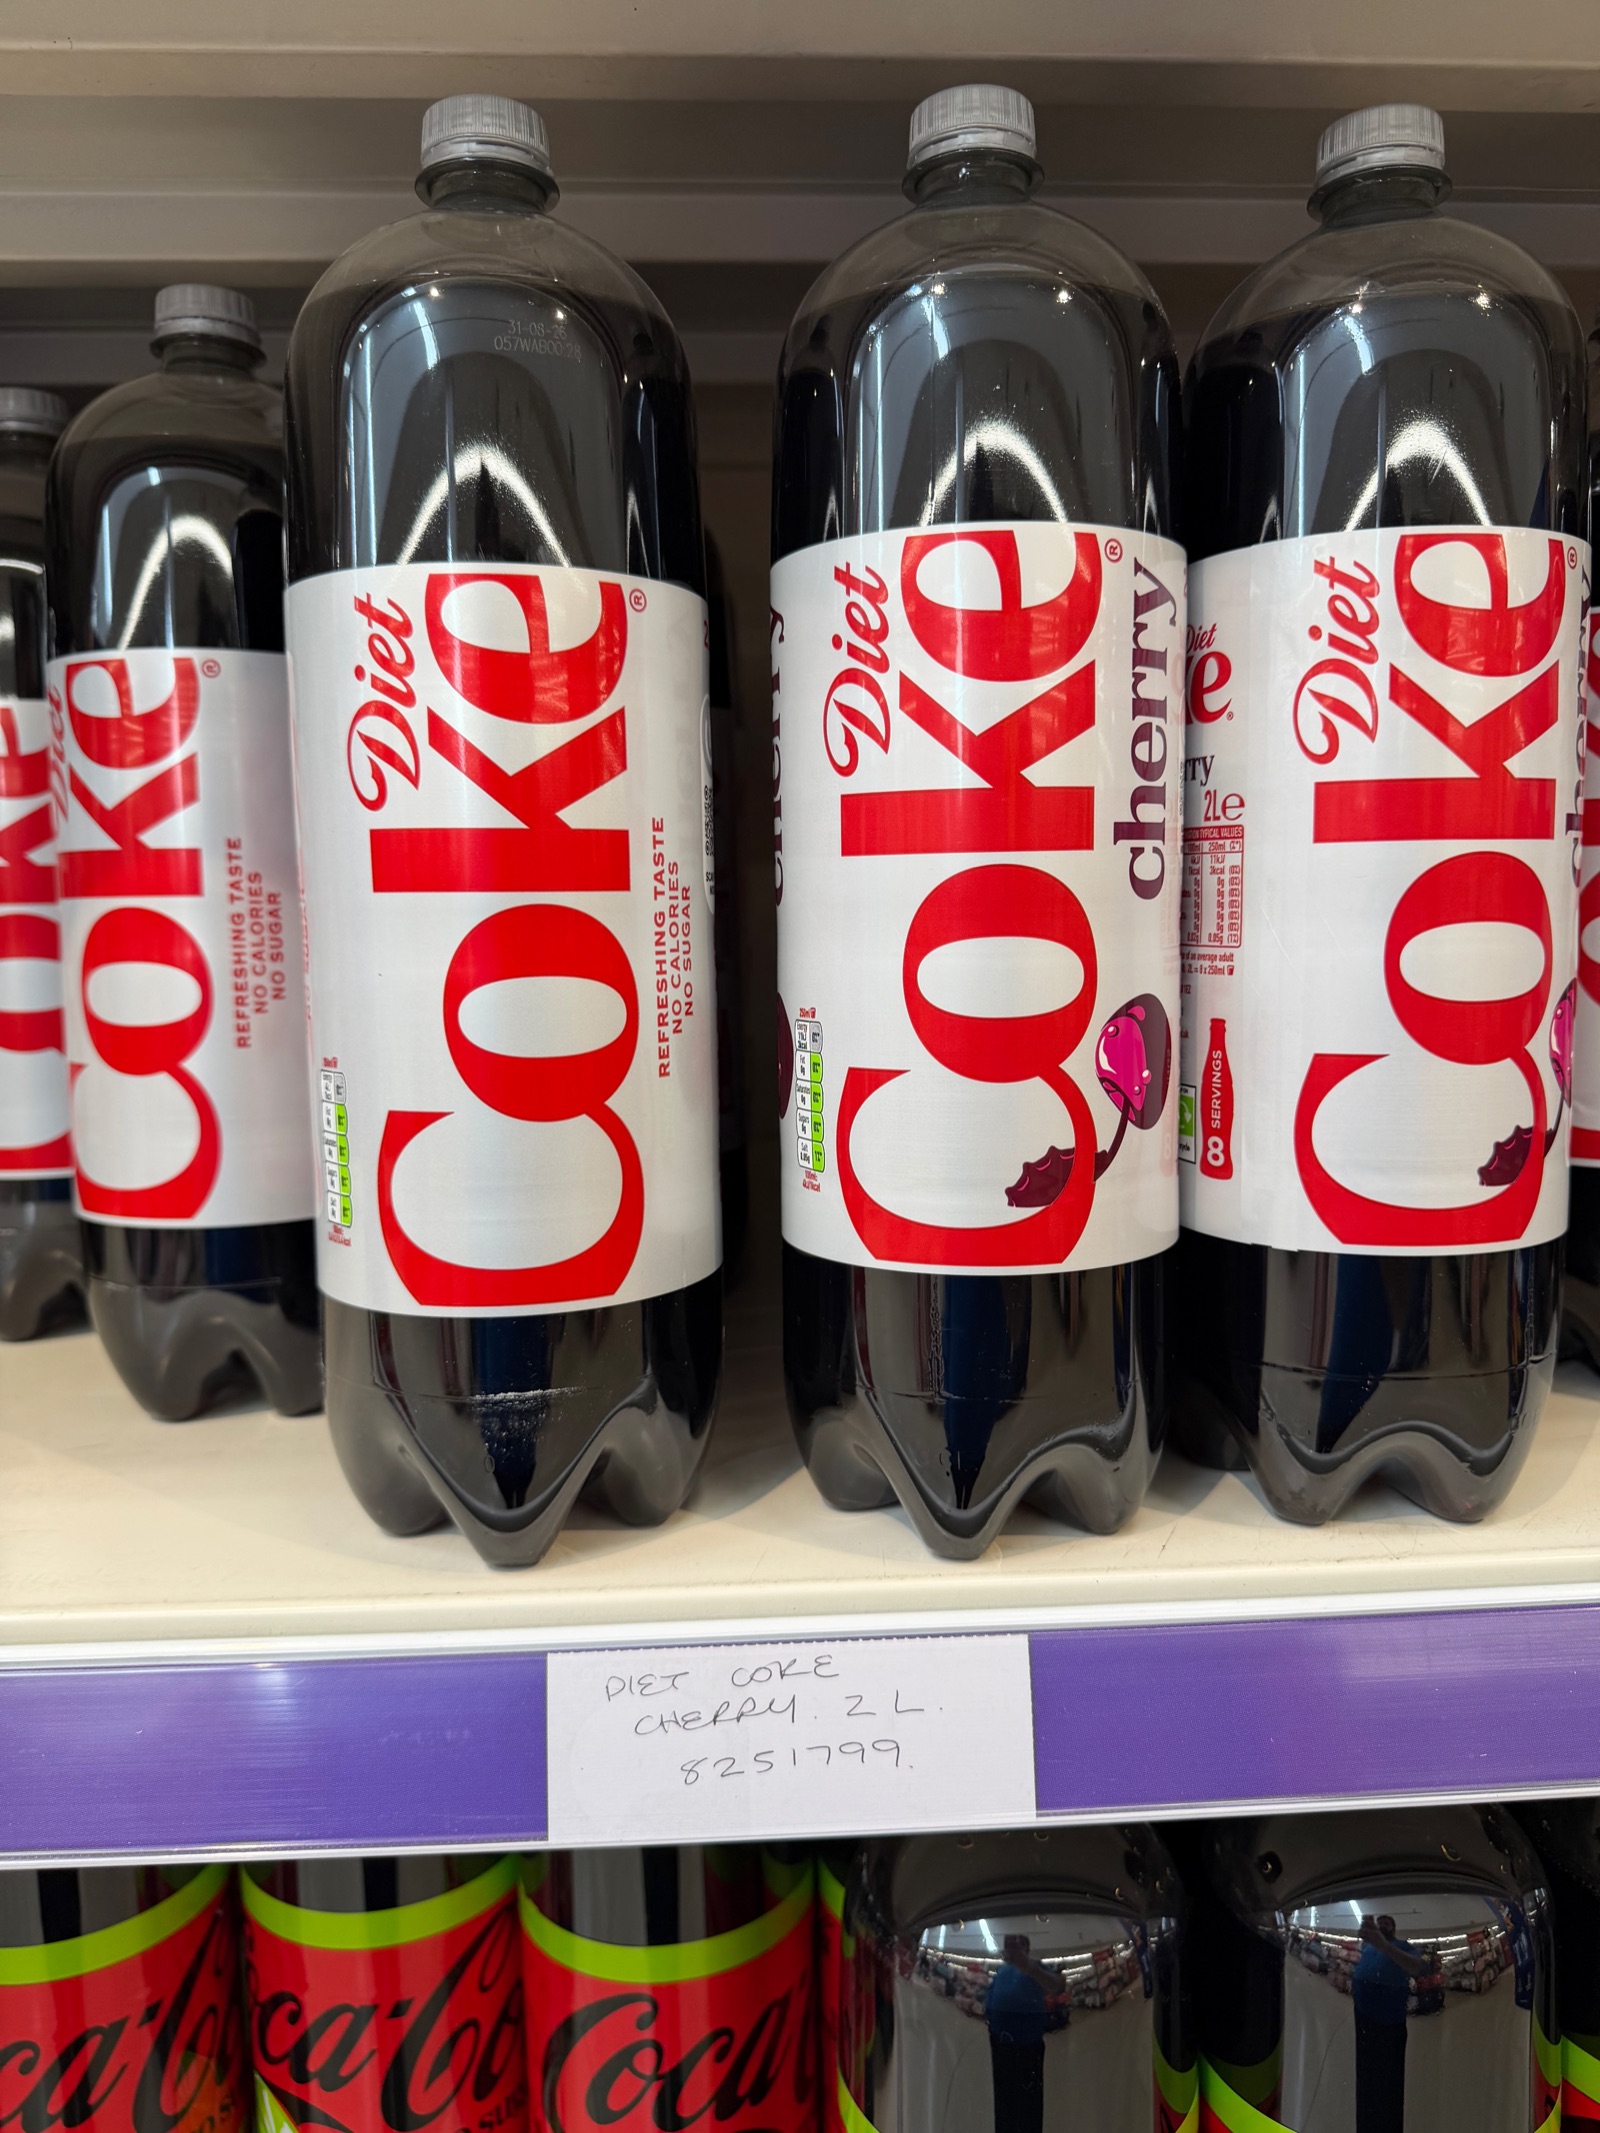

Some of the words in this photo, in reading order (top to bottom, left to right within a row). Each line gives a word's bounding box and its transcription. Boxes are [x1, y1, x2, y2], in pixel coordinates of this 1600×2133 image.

[823, 561, 891, 778] Diet
[1293, 557, 1380, 766] Diet
[347, 592, 421, 812] Diet
[1112, 556, 1177, 901] cherry
[651, 817, 665, 901] TASTE
[1221, 827, 1243, 838] VALUES
[226, 837, 243, 904] TASTE
[248, 872, 267, 977] CALORIES
[267, 892, 285, 963] SUGAR
[668, 861, 682, 989] CALORIES
[682, 885, 692, 972] SUGAR
[1197, 953, 1217, 963] average
[1219, 952, 1234, 962] adult
[231, 913, 251, 1049] REFRESHING
[254, 984, 269, 1014] NO
[271, 971, 286, 1000] NO
[653, 911, 671, 1078] REFRESHING
[672, 999, 683, 1034] NO
[684, 981, 694, 1016] NO
[1211, 1050, 1222, 1129] SERVINGS
[1207, 1135, 1225, 1167] 8
[731, 1654, 839, 1687] COKE
[845, 1695, 877, 1717] 2
